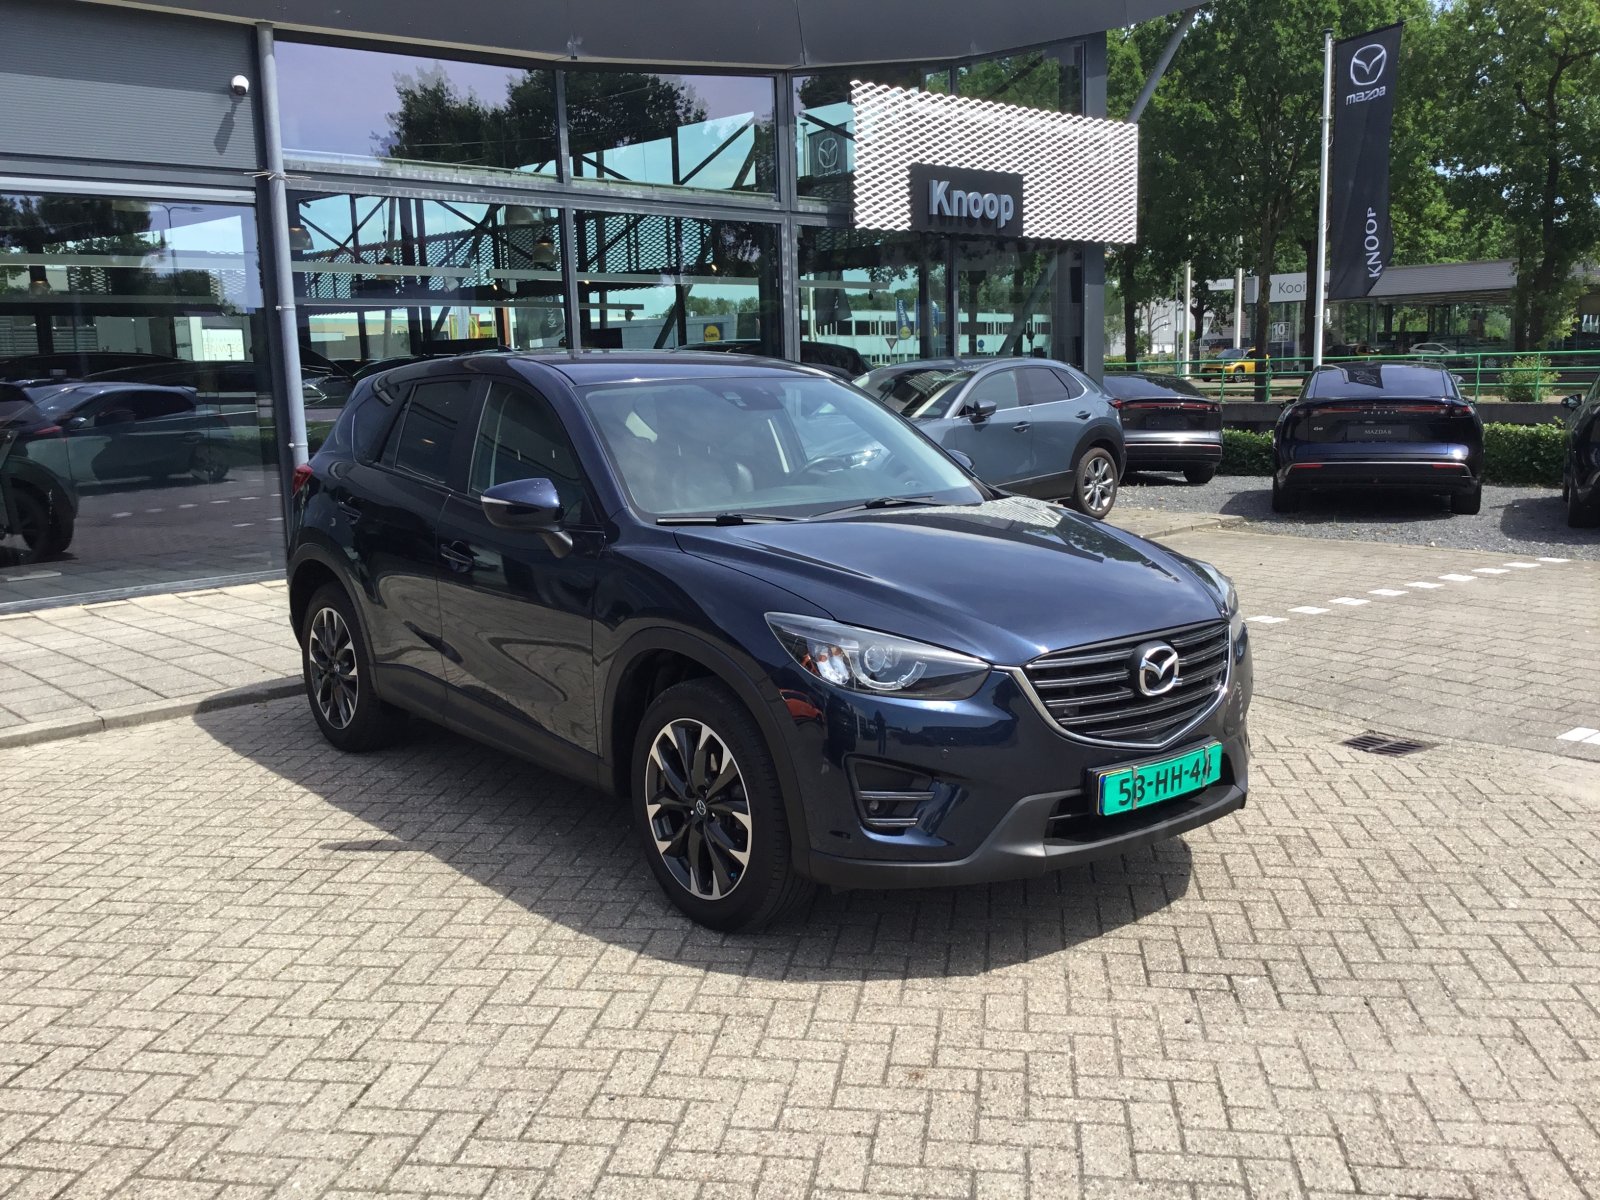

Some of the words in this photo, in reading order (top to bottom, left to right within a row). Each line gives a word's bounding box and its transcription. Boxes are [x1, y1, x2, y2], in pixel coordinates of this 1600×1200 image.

[928, 179, 1014, 229] Knoop
[1364, 206, 1383, 278] KNOOP
[1278, 280, 1306, 294] Kooi
